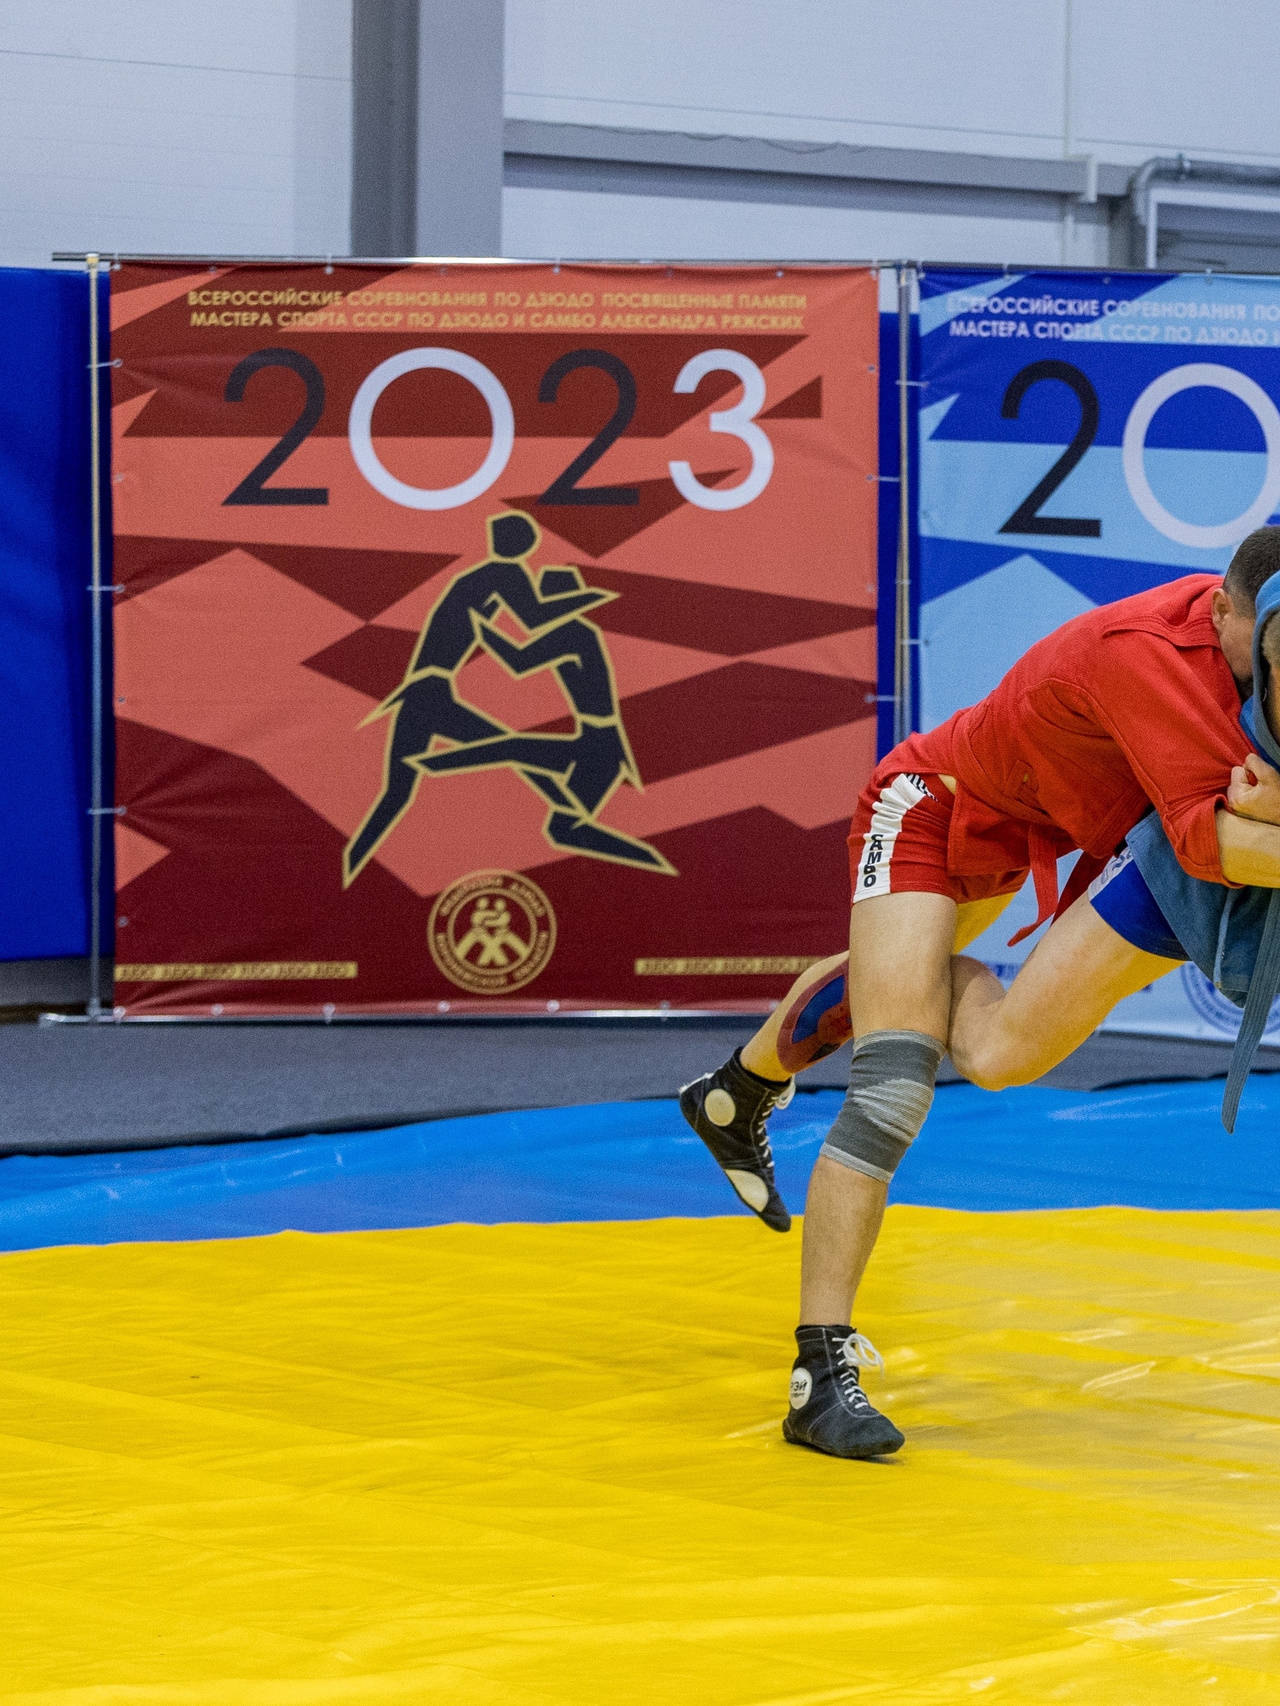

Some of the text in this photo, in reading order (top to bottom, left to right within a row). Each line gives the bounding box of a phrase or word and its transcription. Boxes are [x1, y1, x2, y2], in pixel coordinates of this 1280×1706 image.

[187, 287, 807, 309] ВСЕРОССИЙСКИЕ СОРЕВНОВАНИЯ ПО ДЗЮДО ПОСВЯЩЕННЫЕ ПАМЯТИ
[947, 294, 1100, 317] ВСЕРОССИЙСКИЕ
[1102, 299, 1247, 320] СОРЕВНОВАНИЯ
[1253, 304, 1280, 322] ПО
[190, 311, 804, 330] МАСТЕРА СПОРТА СССР ПО ДЗЮДО И САМБО АЛЕКСАНДРА РЯЖСКИХ
[949, 320, 1030, 337] МАСТЕРА
[1033, 322, 1103, 339] СПОРТА
[1107, 324, 1160, 341] СССР
[1164, 325, 1192, 343] ПО
[1196, 326, 1268, 345] ДЗЮДО
[222, 346, 775, 511] 2023
